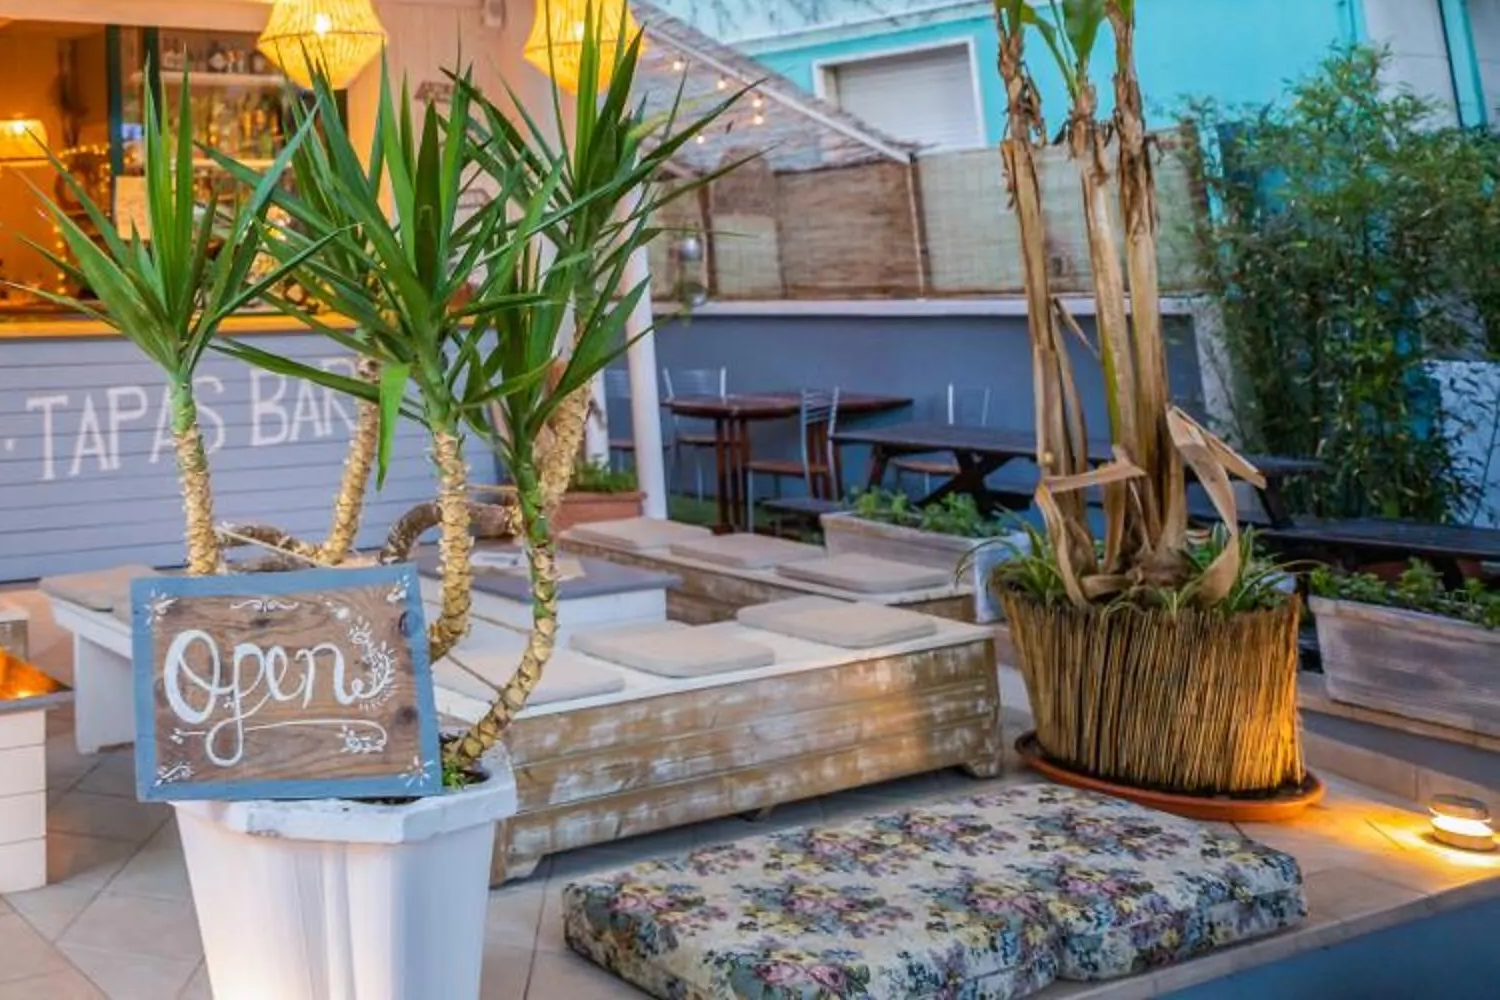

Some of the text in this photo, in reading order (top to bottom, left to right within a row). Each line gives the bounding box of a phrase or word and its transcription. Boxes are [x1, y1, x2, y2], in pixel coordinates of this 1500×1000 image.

[26, 357, 360, 480] TAPAS BAR
[164, 629, 362, 767] Open
